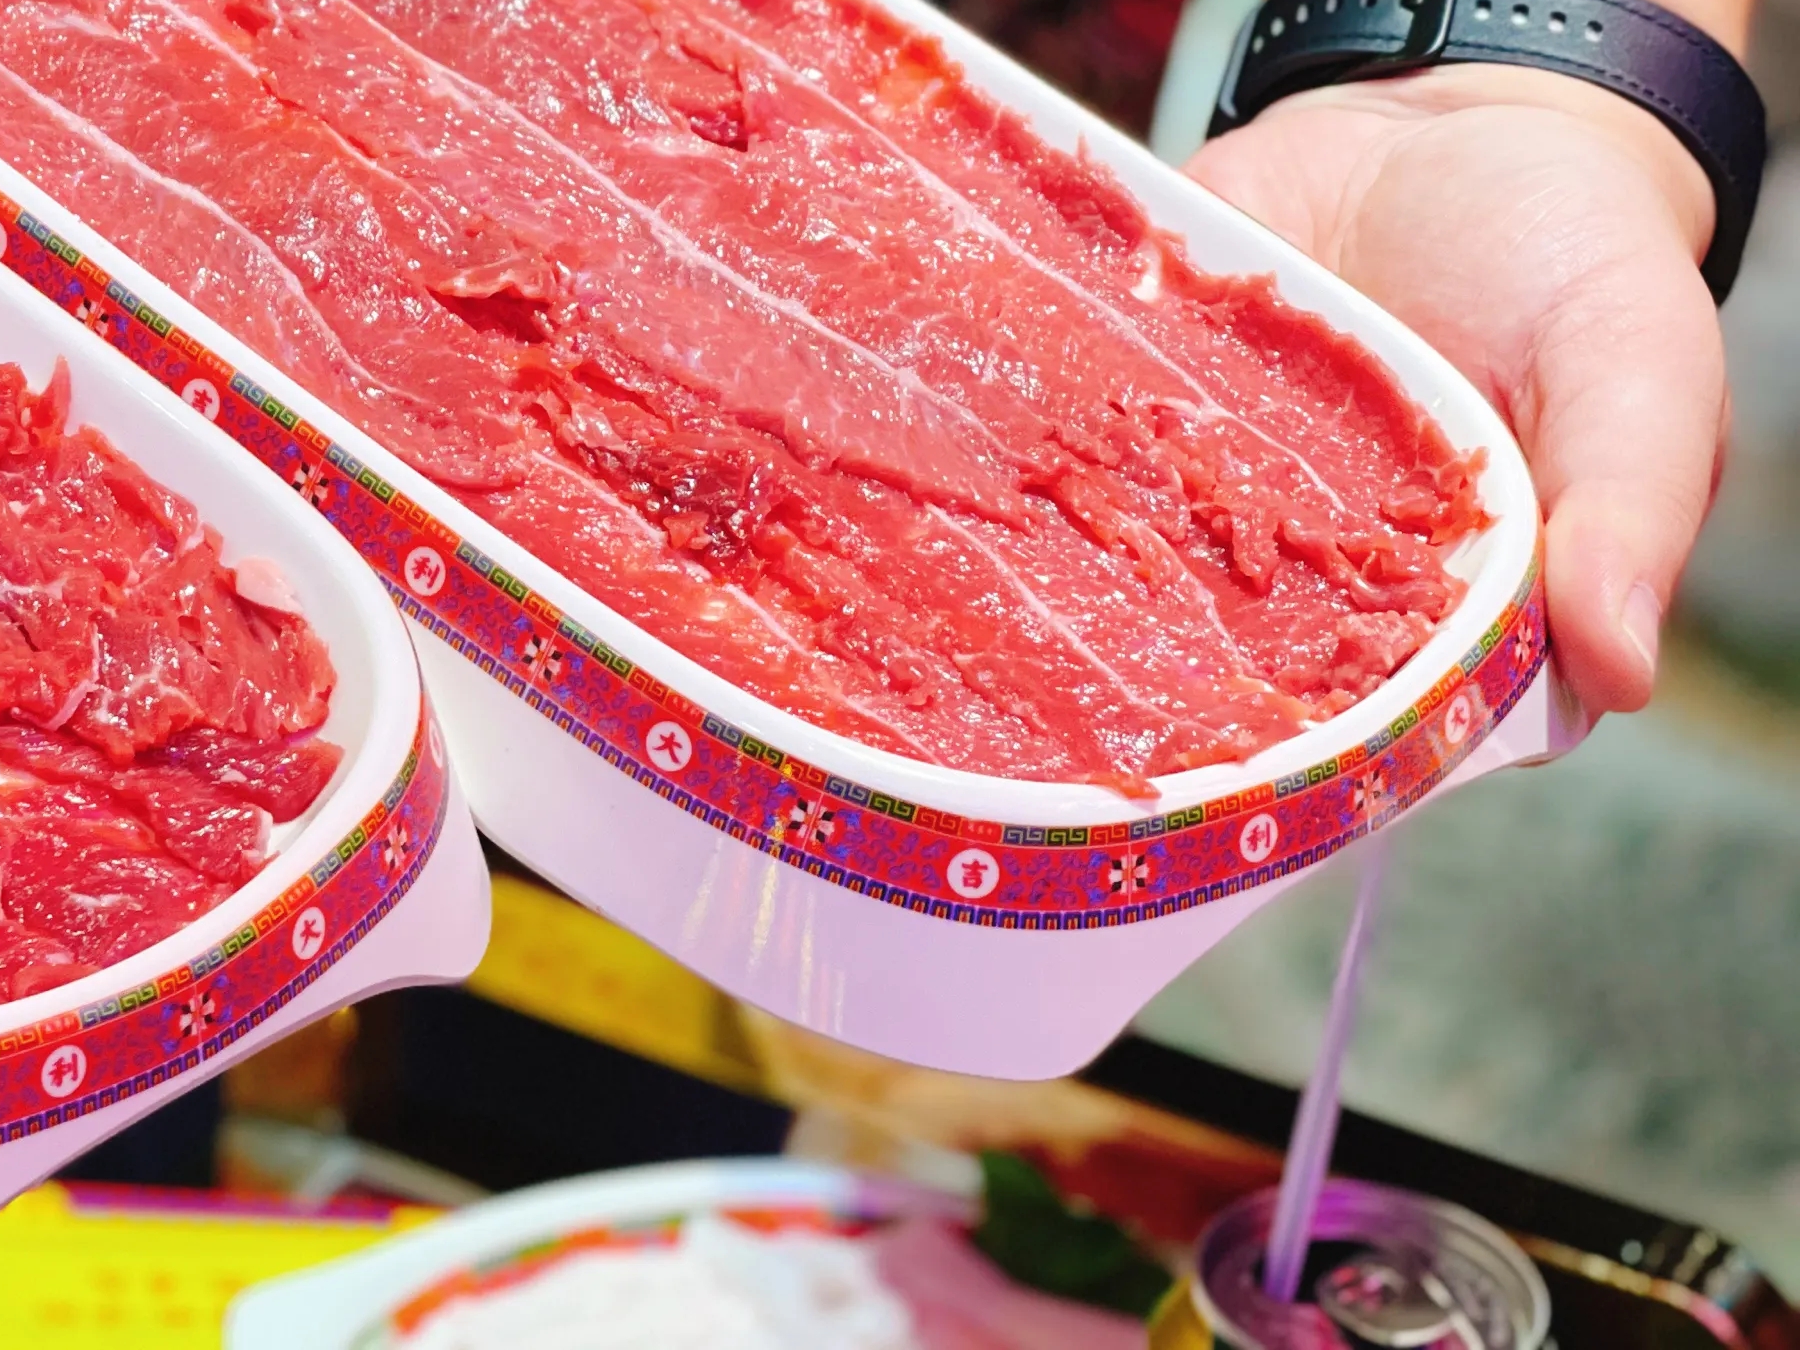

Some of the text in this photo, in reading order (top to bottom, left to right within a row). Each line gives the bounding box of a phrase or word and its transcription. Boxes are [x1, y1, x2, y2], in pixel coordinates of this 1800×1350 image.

[412, 555, 440, 589] 利
[652, 730, 684, 766] 大
[1246, 821, 1272, 853] 利
[960, 857, 989, 890] 吉
[299, 917, 322, 954] 大
[47, 1052, 80, 1088] 利
